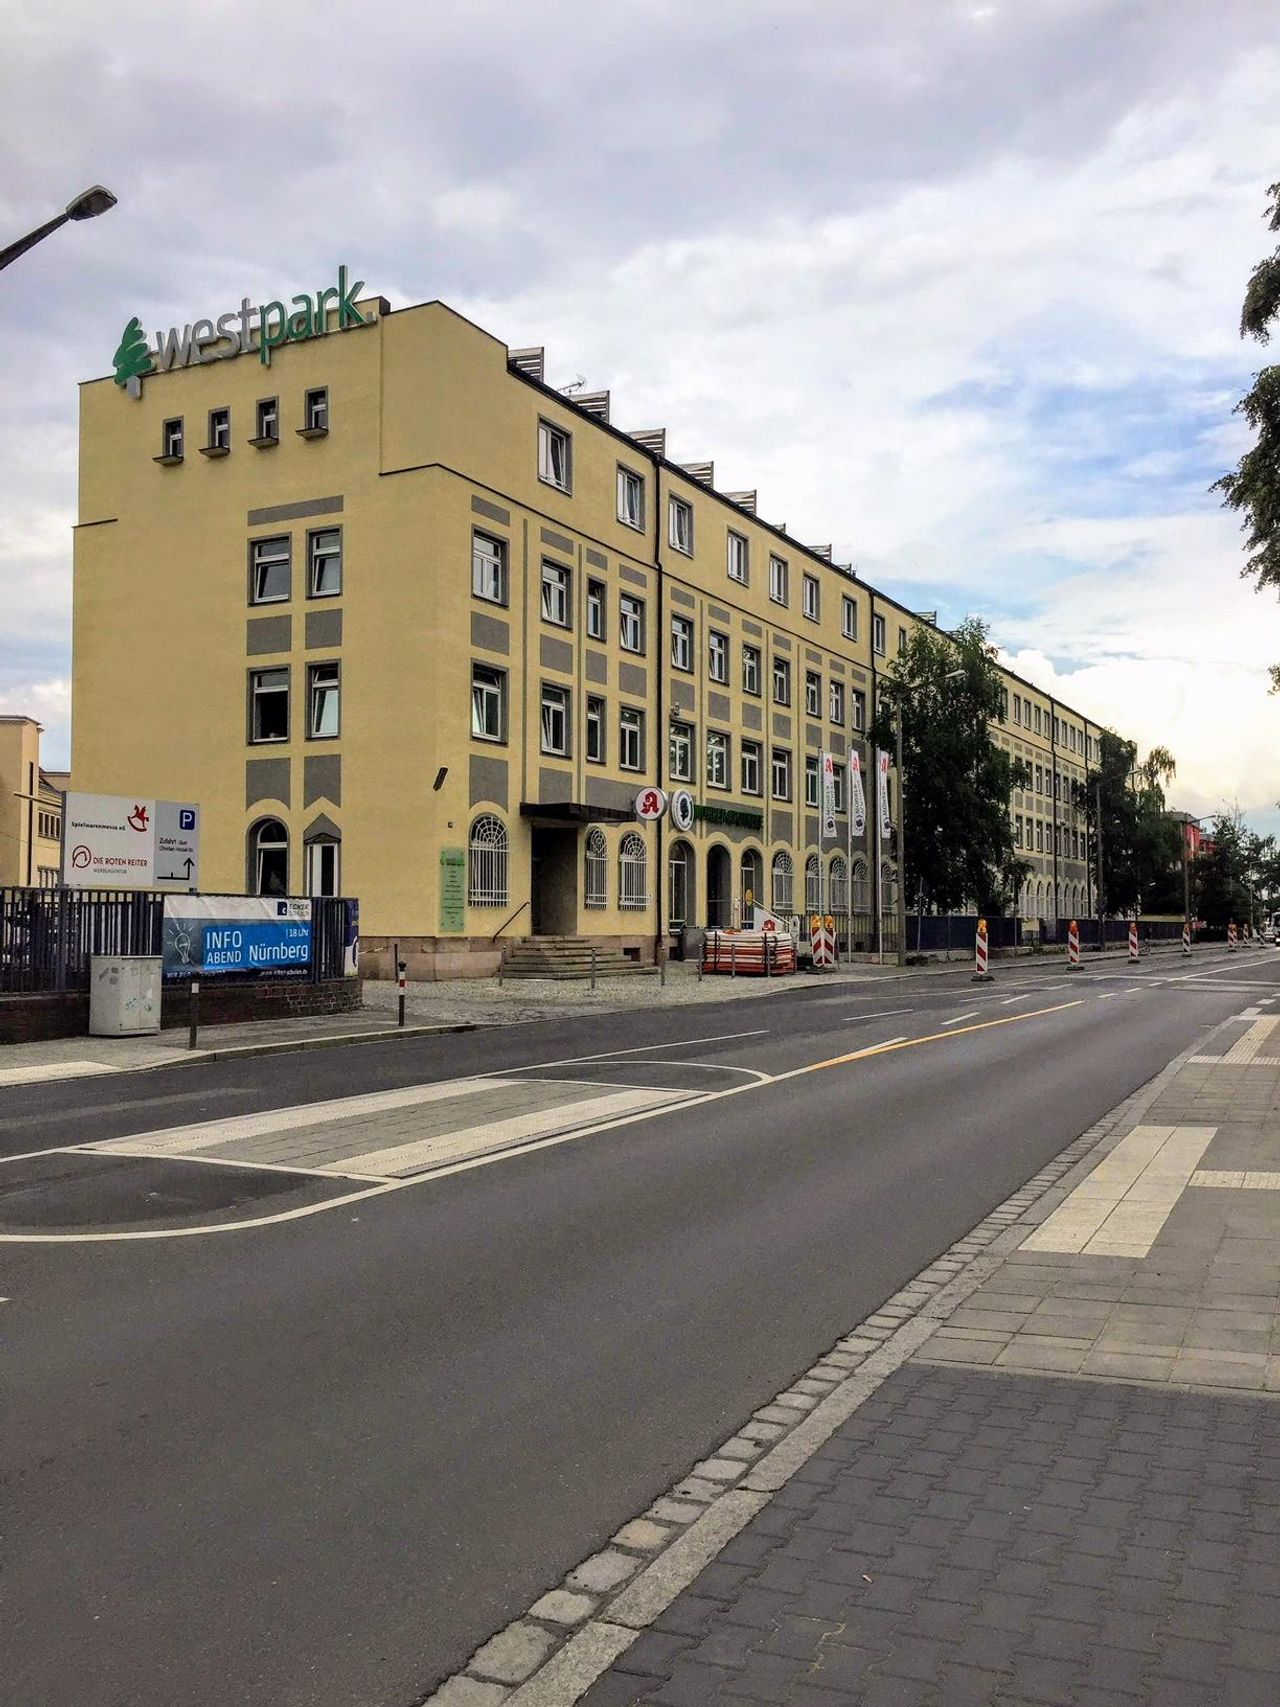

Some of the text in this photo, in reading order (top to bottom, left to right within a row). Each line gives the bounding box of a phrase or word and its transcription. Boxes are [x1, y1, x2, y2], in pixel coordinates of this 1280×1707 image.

[182, 812, 193, 828] P
[93, 856, 148, 867] DIE ROTEN REITER
[206, 930, 242, 949] INFO
[289, 927, 309, 937] 18 Uhr
[206, 950, 242, 964] ABEND
[249, 942, 308, 962] Nürnberg
